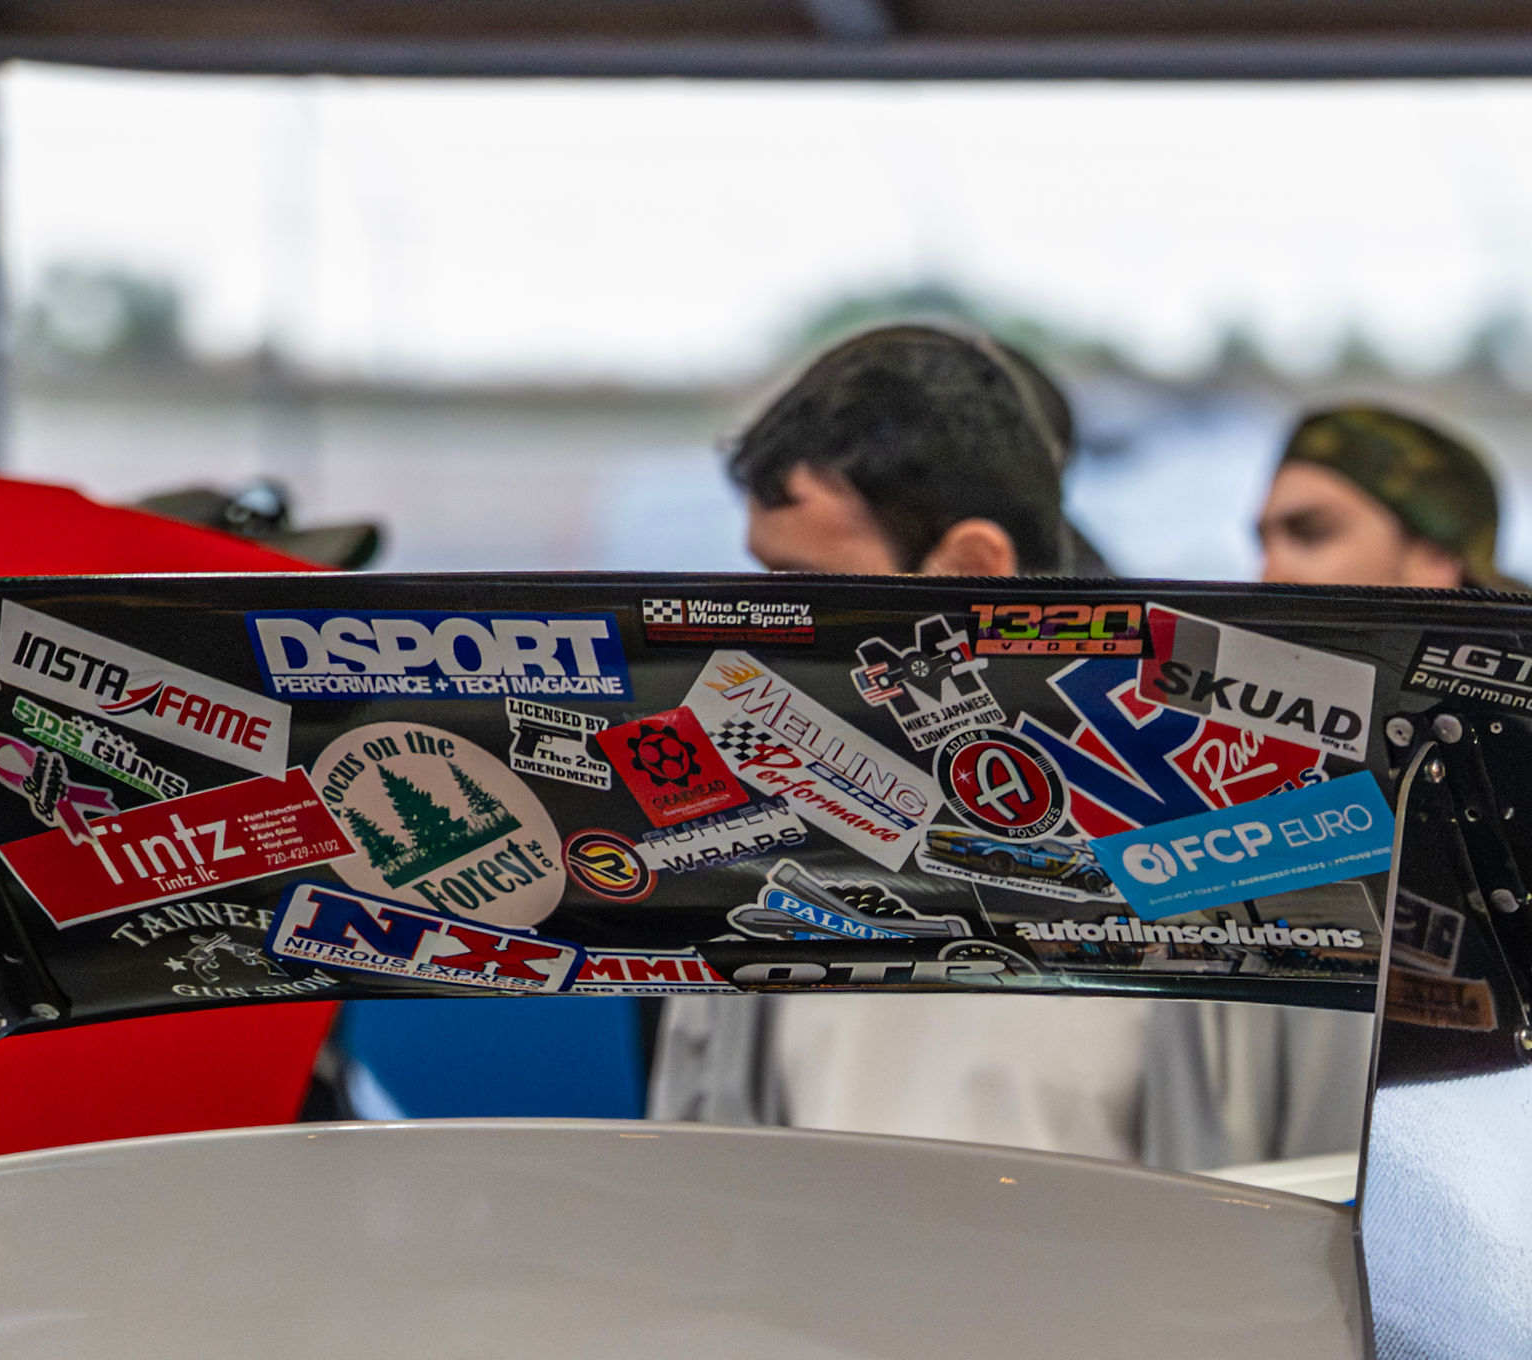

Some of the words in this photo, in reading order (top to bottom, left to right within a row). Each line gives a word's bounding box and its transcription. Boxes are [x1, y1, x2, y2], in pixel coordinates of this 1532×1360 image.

[687, 600, 734, 613] Wine
[736, 601, 810, 616] Country
[688, 612, 746, 625] Motor
[749, 613, 814, 627] Sports
[971, 603, 1143, 640] 1320
[255, 617, 609, 676] DSPORT
[1002, 641, 1117, 652] VIDEO
[12, 631, 129, 701] INSTA
[155, 685, 272, 752] FAME
[272, 674, 432, 694] PERFORMANCE
[451, 676, 508, 694] TECH
[511, 677, 625, 695] MAGAZINE
[1154, 661, 1362, 741] SKUAD
[509, 699, 582, 728] LICENSED
[585, 713, 607, 733] BY
[940, 693, 994, 720] JAPANESE
[975, 709, 1003, 725] AUTO
[363, 731, 401, 762] on
[405, 729, 456, 759] the
[538, 748, 573, 765] The
[575, 755, 608, 773] 2ND
[721, 675, 928, 819] MELLING
[91, 740, 186, 797] GUNS
[513, 758, 608, 787] AMENDMENT
[739, 743, 902, 843] Performance
[1007, 805, 1064, 840] POLISHES
[1171, 822, 1274, 873] FCP
[1279, 804, 1373, 849] EURO
[85, 813, 246, 885] Tintz
[663, 826, 805, 874] WRAPS
[153, 868, 198, 893] Tintz
[412, 838, 546, 916] Forest
[1016, 916, 1364, 948] autofilmsolutions
[284, 936, 409, 969] NITROUS
[415, 962, 545, 990] EXPRESS
[172, 983, 248, 998] GUN
[255, 968, 341, 998] SHOW
